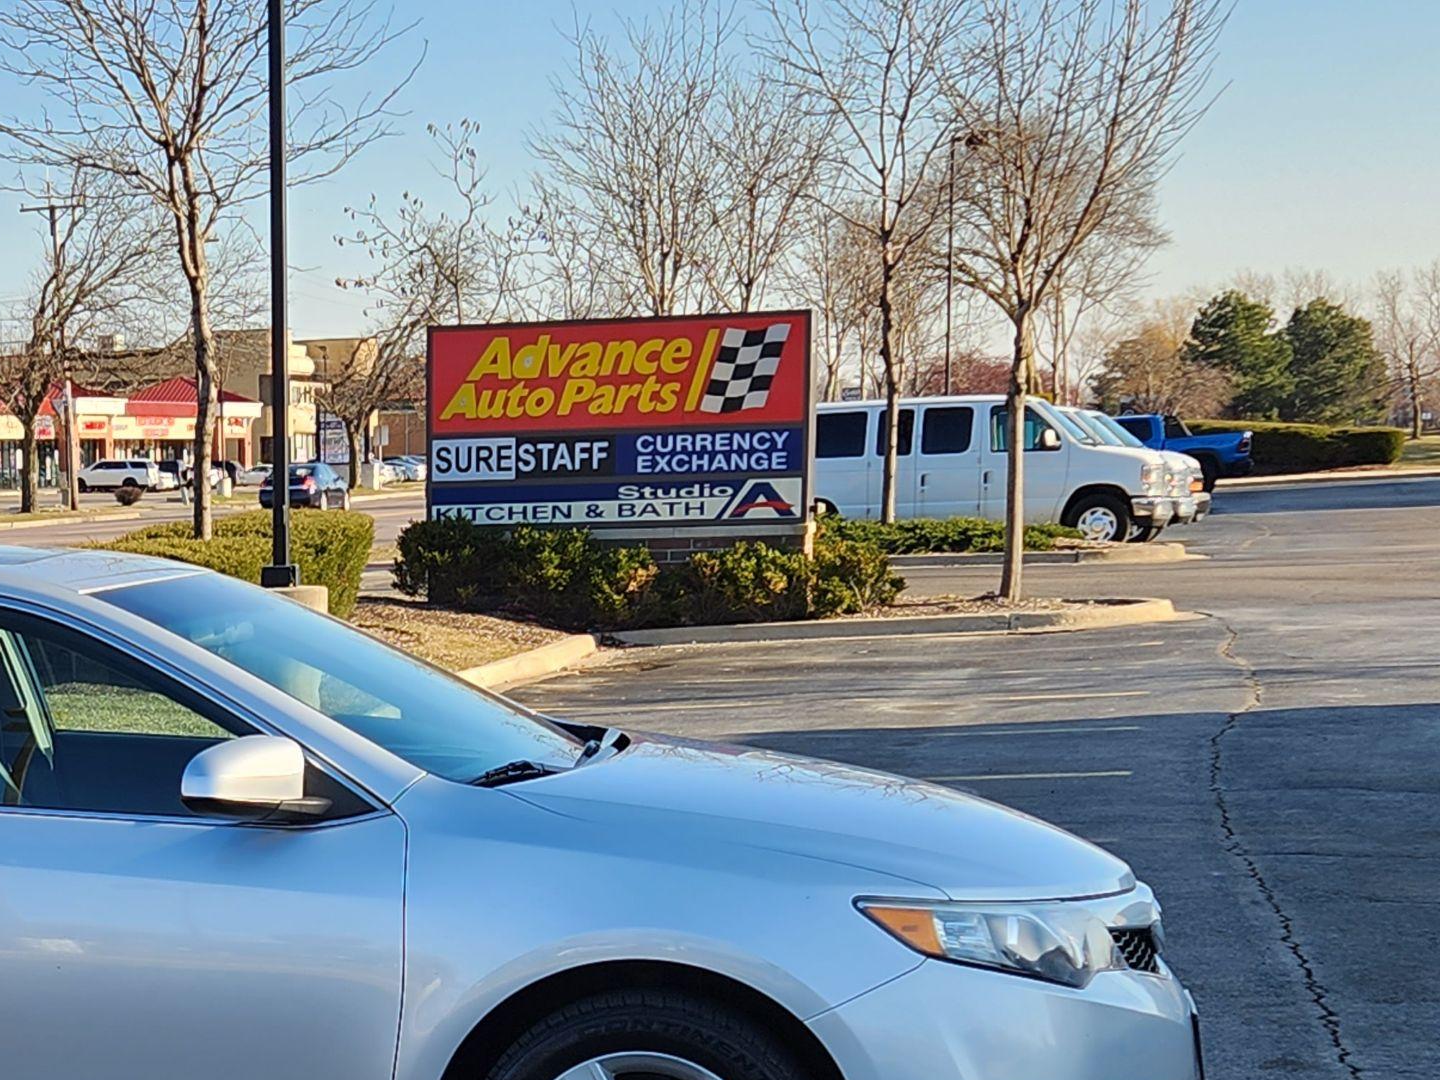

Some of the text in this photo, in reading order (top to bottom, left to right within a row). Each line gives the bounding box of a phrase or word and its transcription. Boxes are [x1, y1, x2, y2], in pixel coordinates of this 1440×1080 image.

[466, 334, 692, 381] Advance
[439, 377, 681, 421] Auto Parts
[636, 431, 790, 454] CURRENCY
[636, 452, 788, 474] EXCHANGE
[617, 484, 735, 500] Studio
[585, 504, 606, 519] &
[617, 501, 706, 519] BATH
